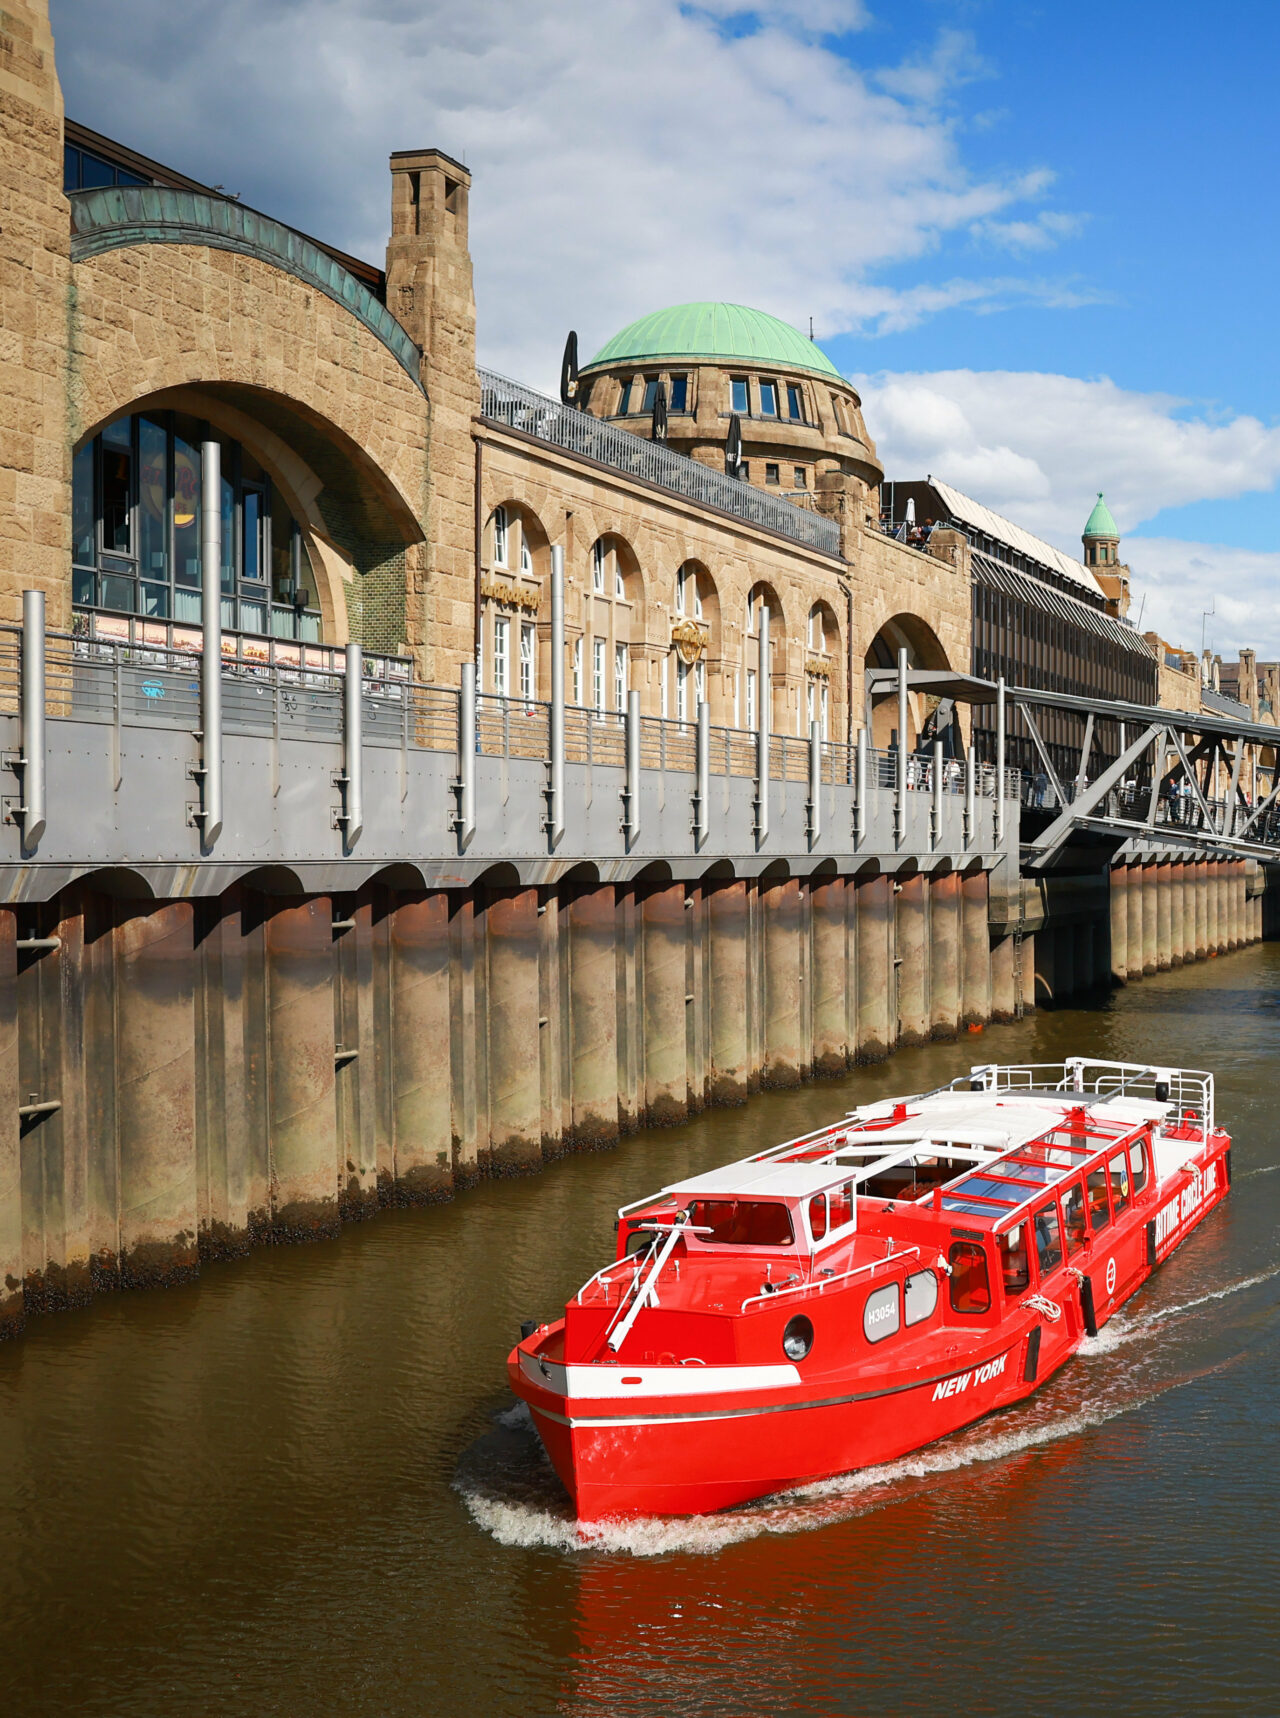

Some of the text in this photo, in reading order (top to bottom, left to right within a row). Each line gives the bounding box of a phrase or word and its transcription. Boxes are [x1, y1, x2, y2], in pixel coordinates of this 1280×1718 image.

[1180, 1173, 1203, 1221] CIRCLE
[1203, 1161, 1217, 1199] LINE
[868, 1301, 896, 1325] H3054
[931, 1354, 1008, 1402] NEW YORK
